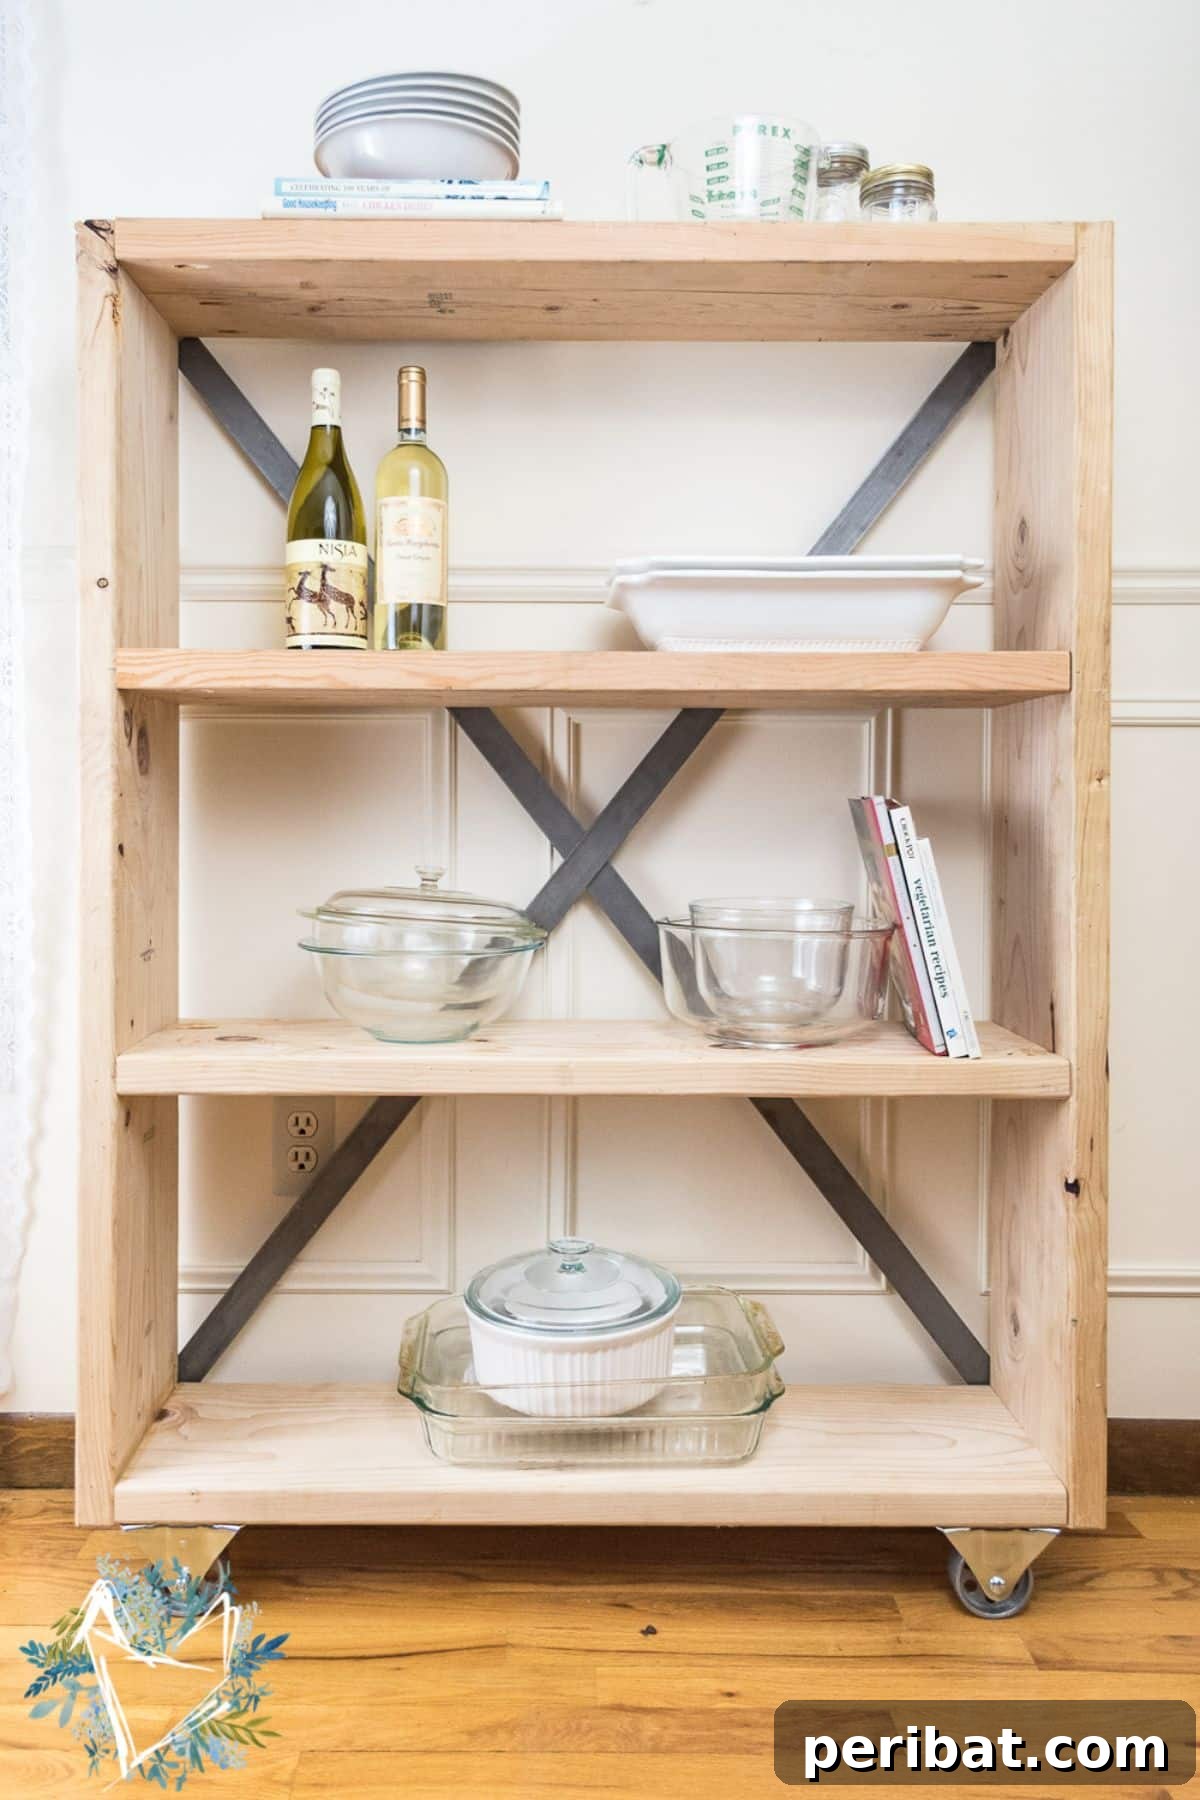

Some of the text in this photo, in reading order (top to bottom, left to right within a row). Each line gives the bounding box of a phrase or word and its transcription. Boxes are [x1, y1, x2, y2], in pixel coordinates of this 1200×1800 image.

[731, 123, 792, 140] PREX
[319, 543, 358, 560] NISIA
[913, 878, 949, 999] vegetarian recipes
